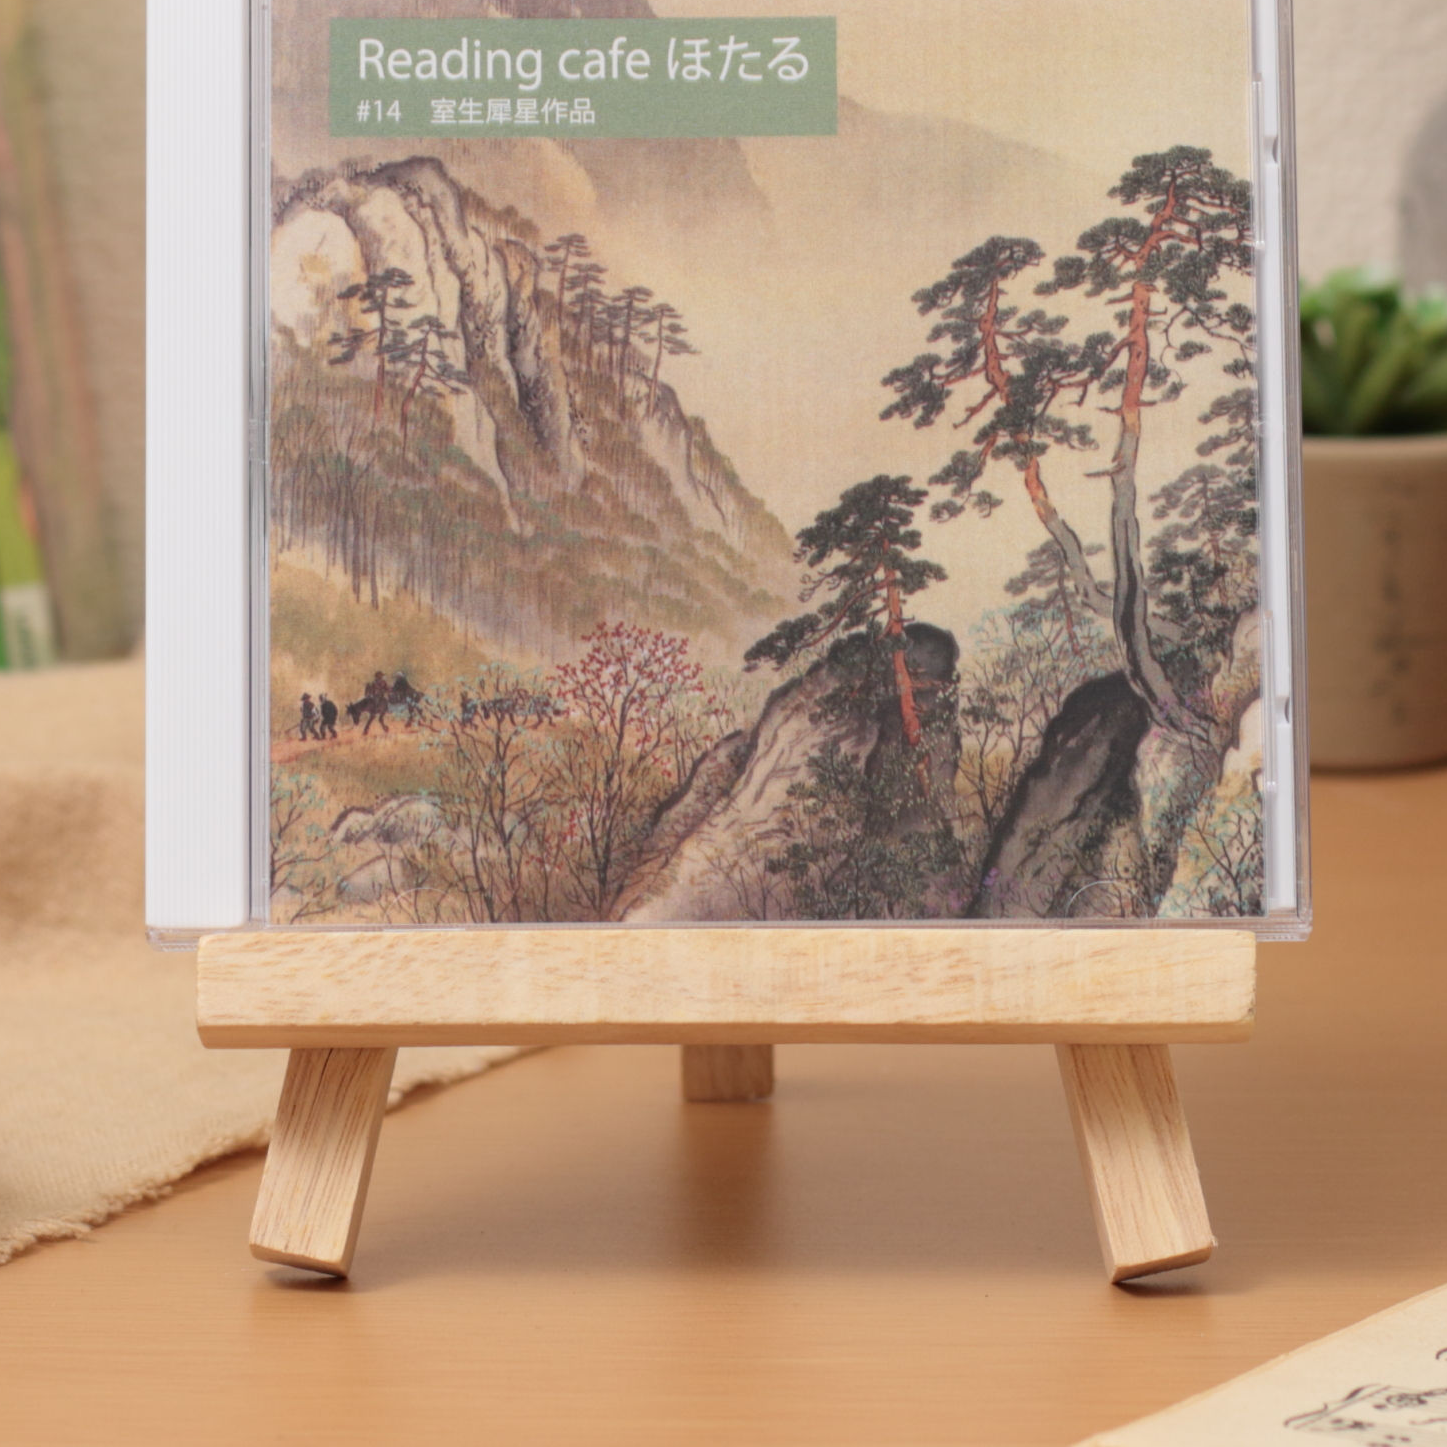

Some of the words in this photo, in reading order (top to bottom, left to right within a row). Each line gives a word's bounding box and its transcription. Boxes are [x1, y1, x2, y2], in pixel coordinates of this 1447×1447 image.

[358, 37, 544, 93] Reading
[557, 35, 651, 82] cafe
[666, 35, 809, 83] ほたる
[355, 98, 403, 124] #14
[430, 96, 596, 126] 室生犀星作品
